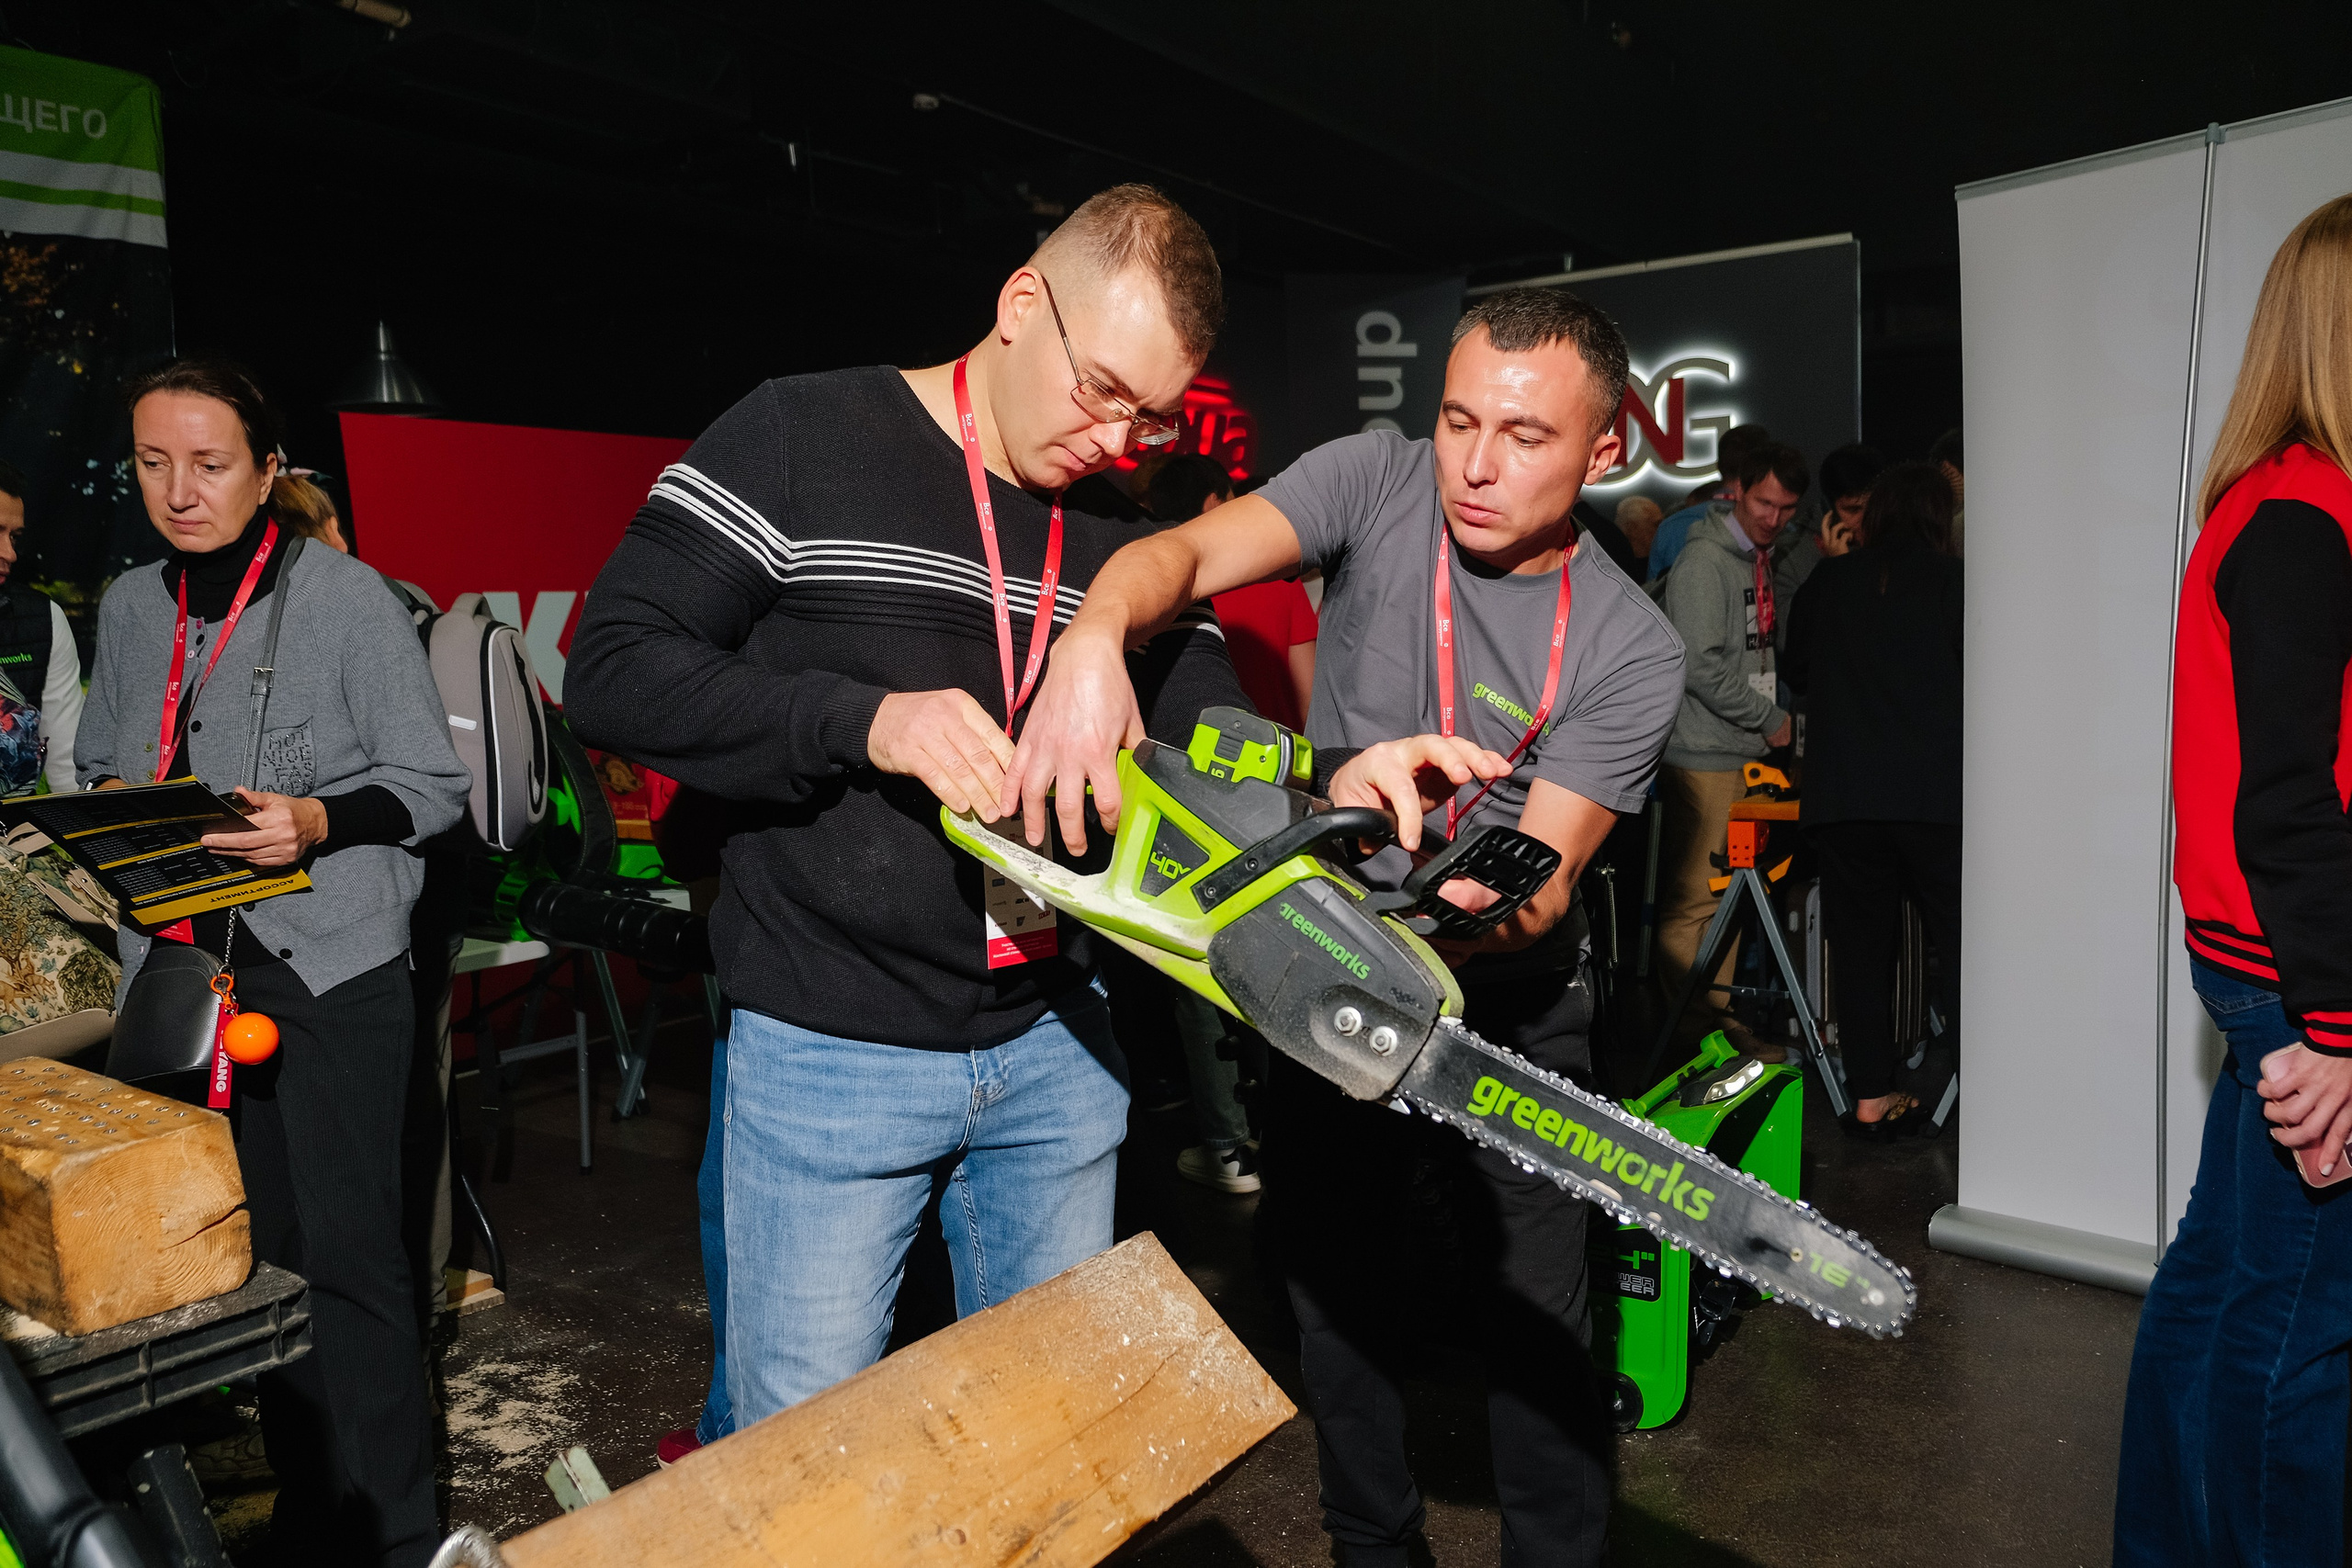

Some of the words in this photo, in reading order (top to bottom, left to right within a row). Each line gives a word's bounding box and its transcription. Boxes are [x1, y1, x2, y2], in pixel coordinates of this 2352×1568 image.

[1042, 582, 1050, 596] Все
[1023, 669, 1033, 683] Все
[209, 879, 294, 903] АССОРТИМЕНТ
[1465, 1075, 1716, 1222] greenworks
